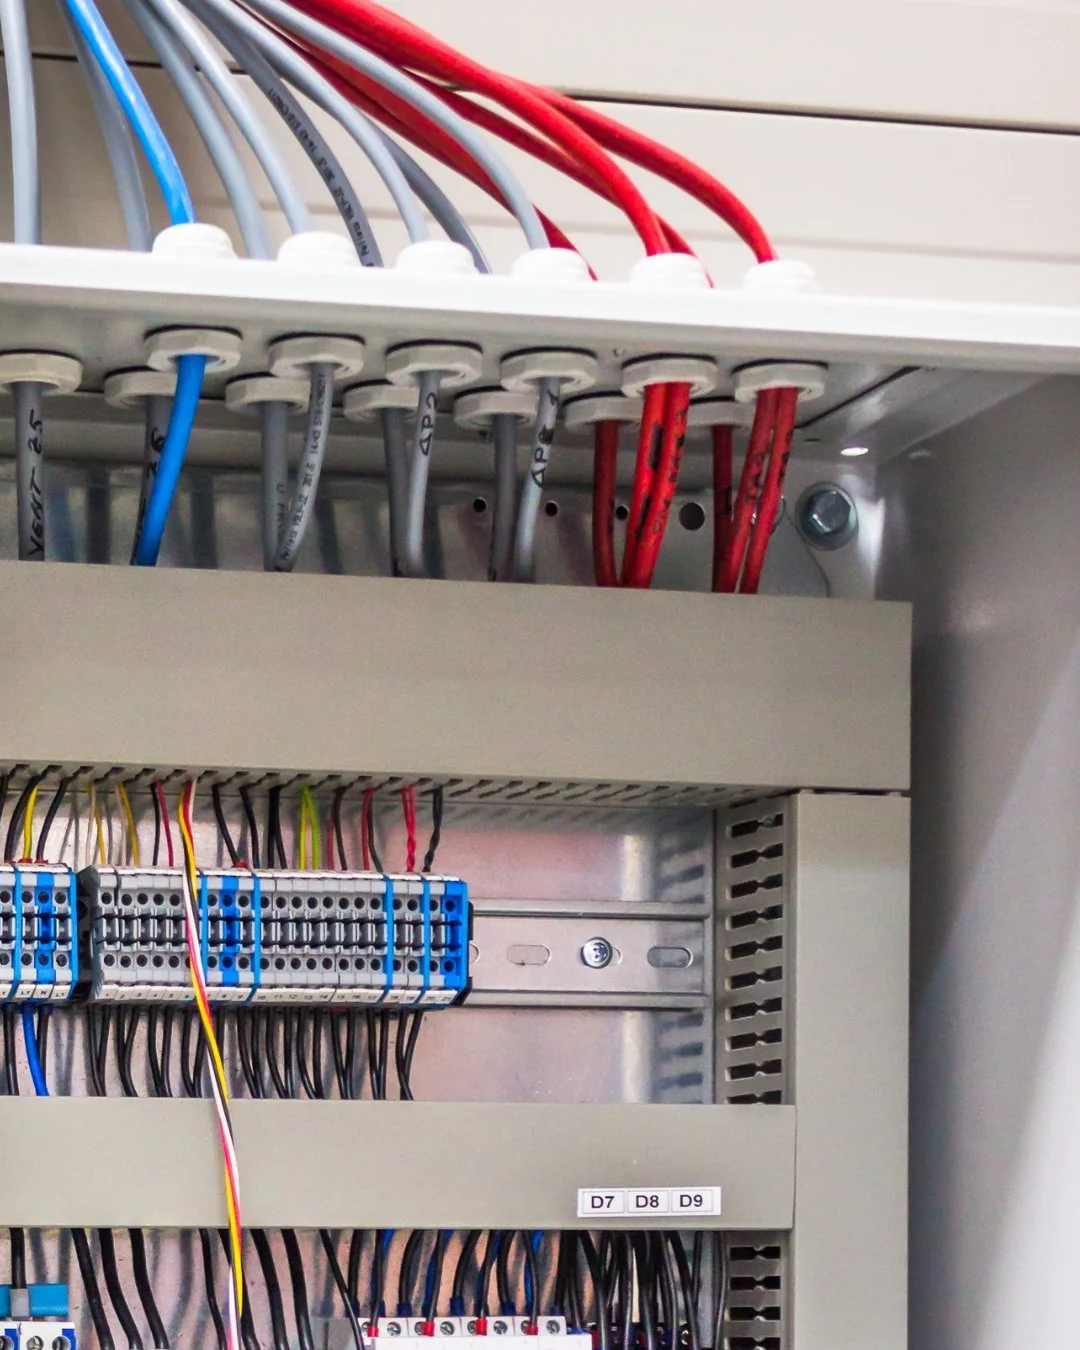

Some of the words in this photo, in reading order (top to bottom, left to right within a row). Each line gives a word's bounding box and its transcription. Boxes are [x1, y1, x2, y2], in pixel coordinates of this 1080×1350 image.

[591, 1195, 615, 1209] D7
[635, 1194, 660, 1208] D8
[679, 1194, 703, 1208] D9
